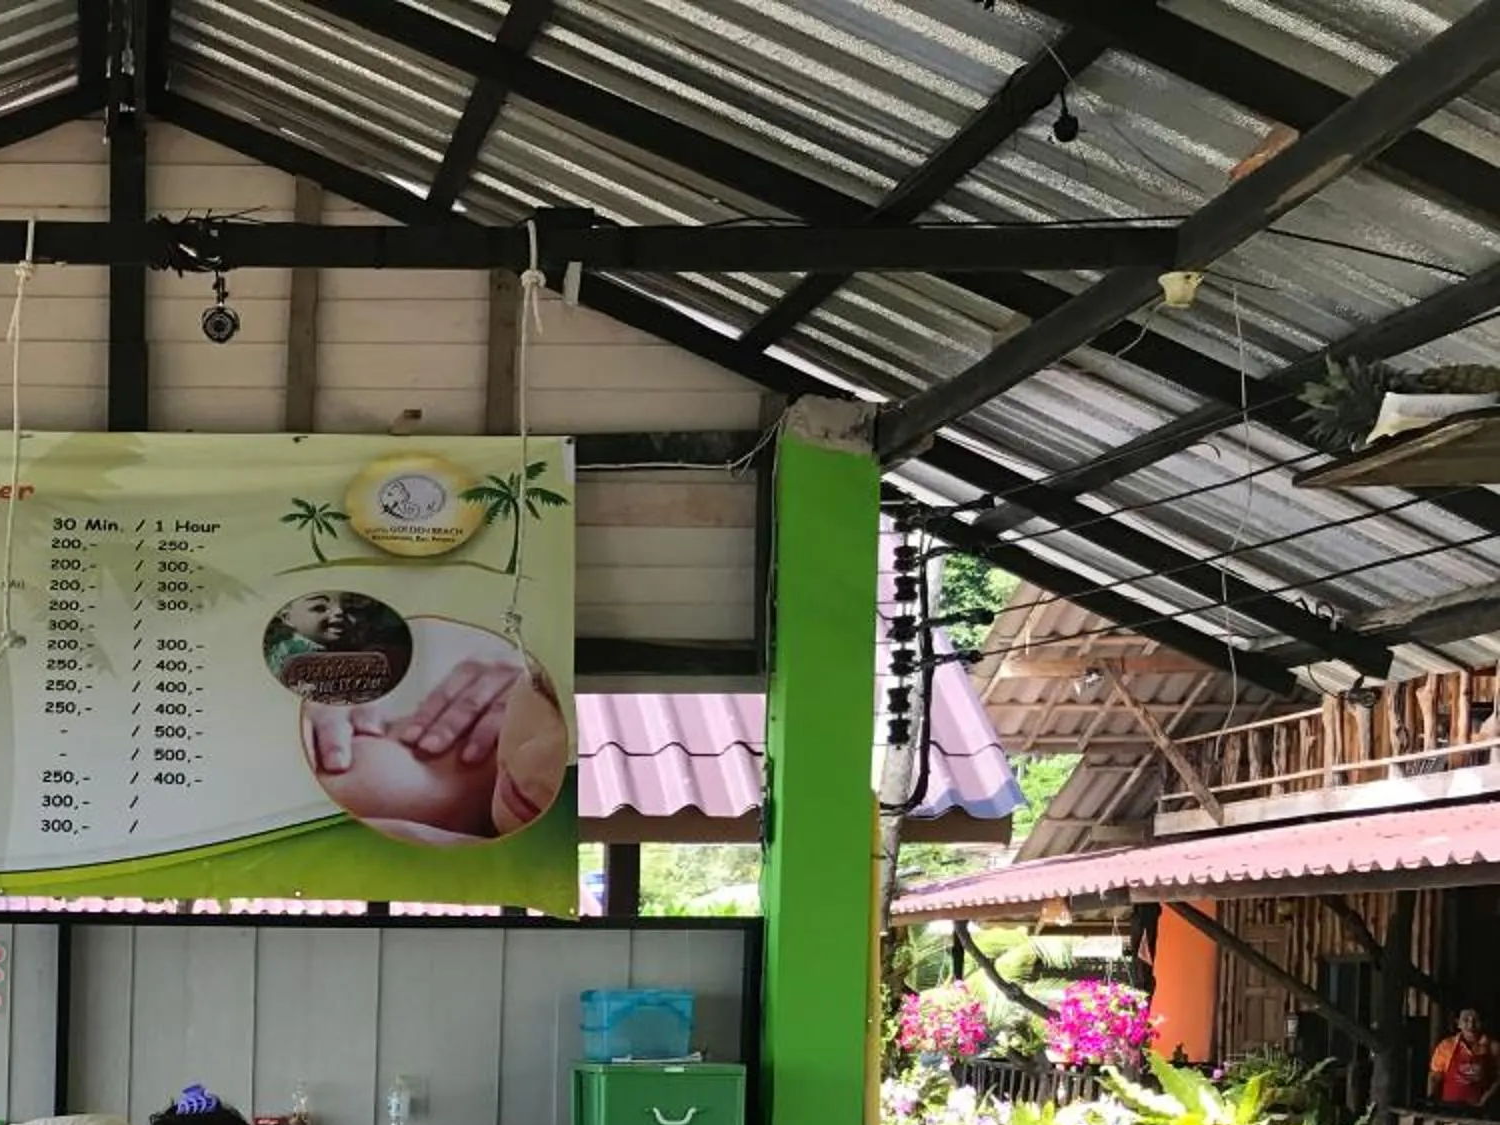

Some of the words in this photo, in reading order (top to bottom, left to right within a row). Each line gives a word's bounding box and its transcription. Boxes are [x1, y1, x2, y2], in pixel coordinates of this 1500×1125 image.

[52, 518, 77, 531] 30
[84, 519, 124, 533] Min.
[155, 520, 164, 532] 1
[175, 520, 221, 533] Hour
